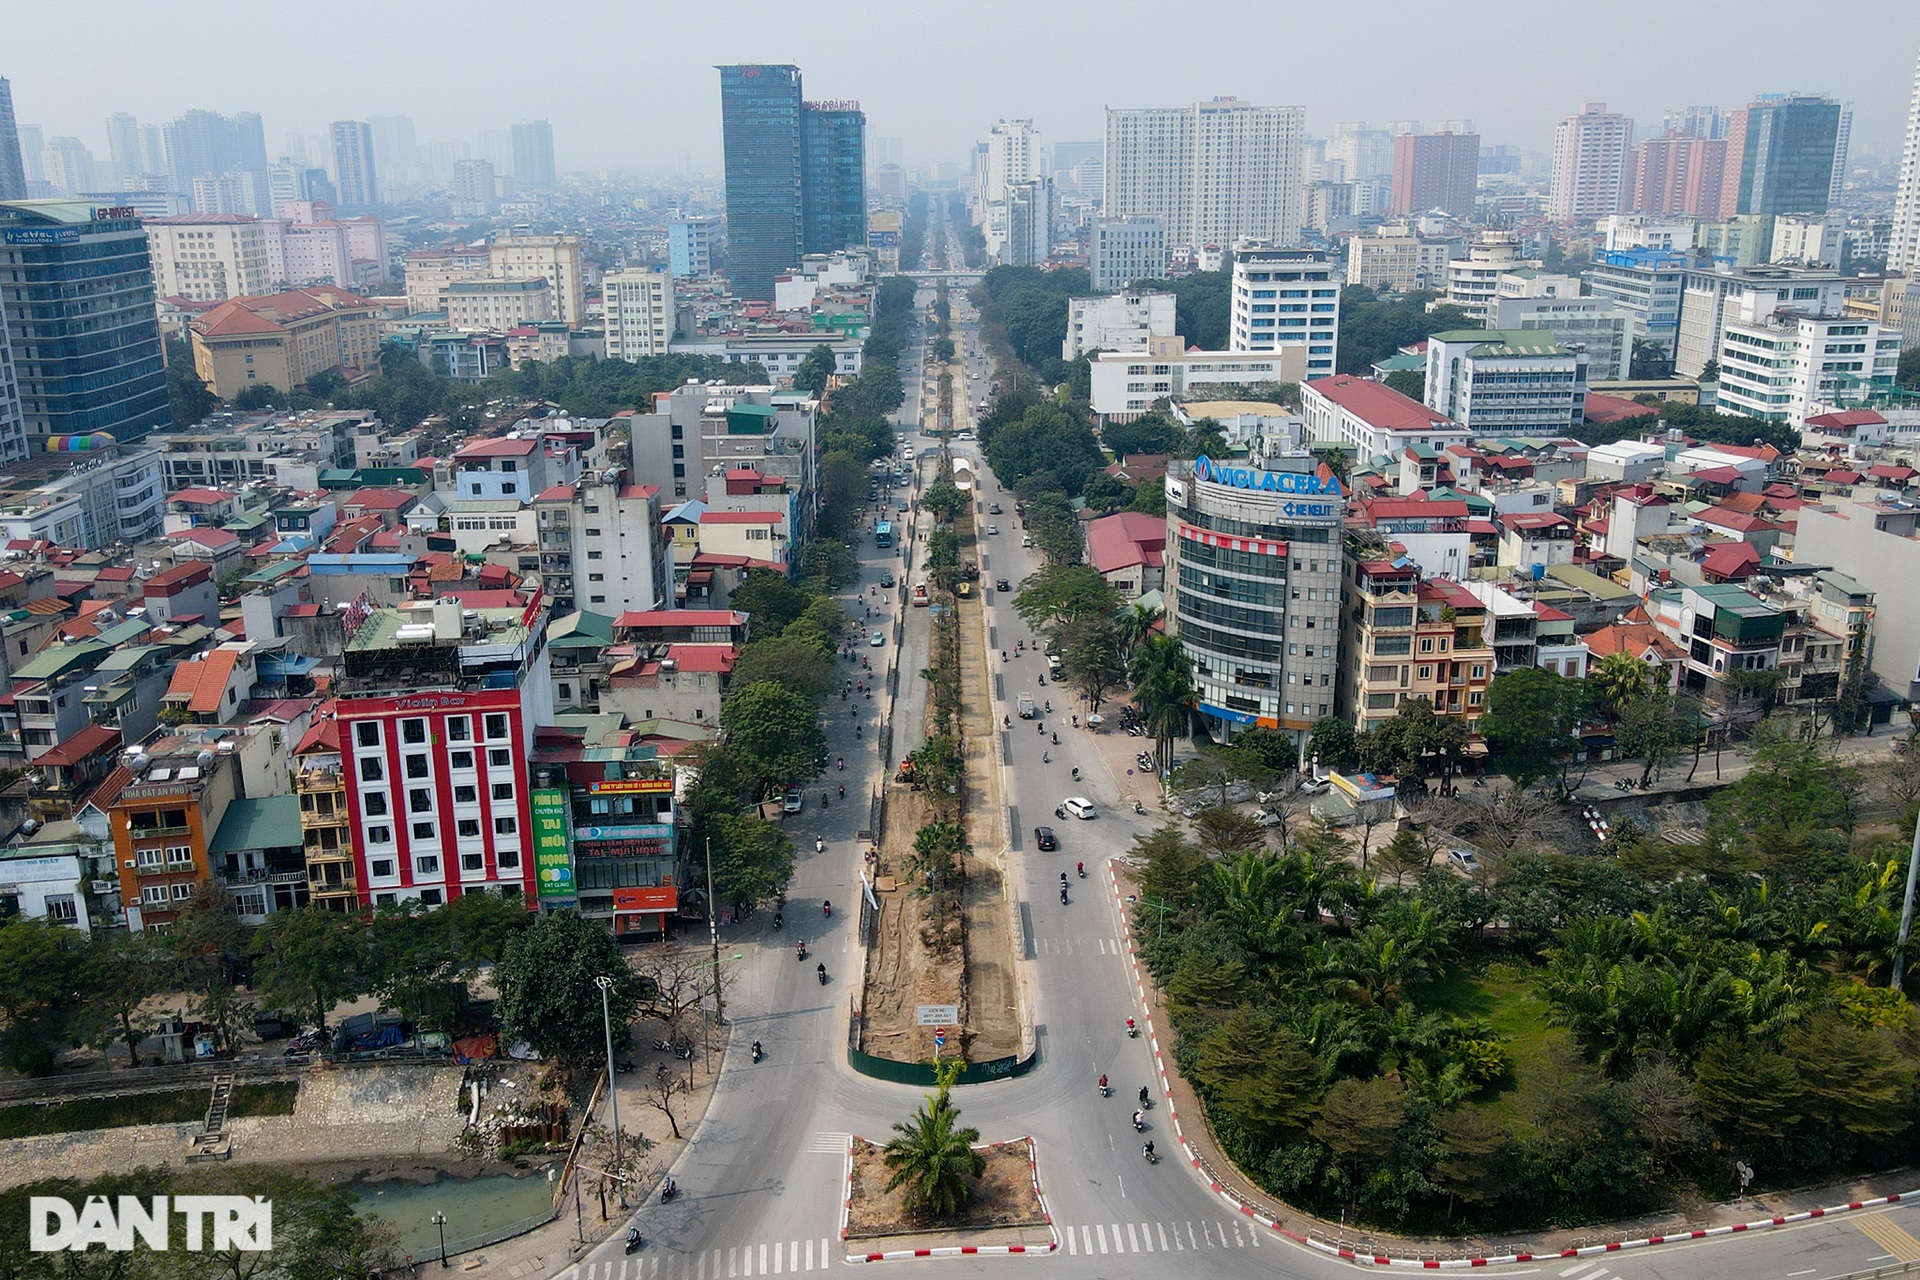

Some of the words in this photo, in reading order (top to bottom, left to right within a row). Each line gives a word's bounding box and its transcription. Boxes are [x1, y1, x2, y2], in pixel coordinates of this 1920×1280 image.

[1215, 466, 1343, 496] VIGLACERA
[395, 697, 438, 709] Violin
[441, 696, 466, 706] Bar
[541, 818, 561, 830] TAI
[541, 834, 566, 848] MŨI
[539, 854, 569, 867] HỌNG
